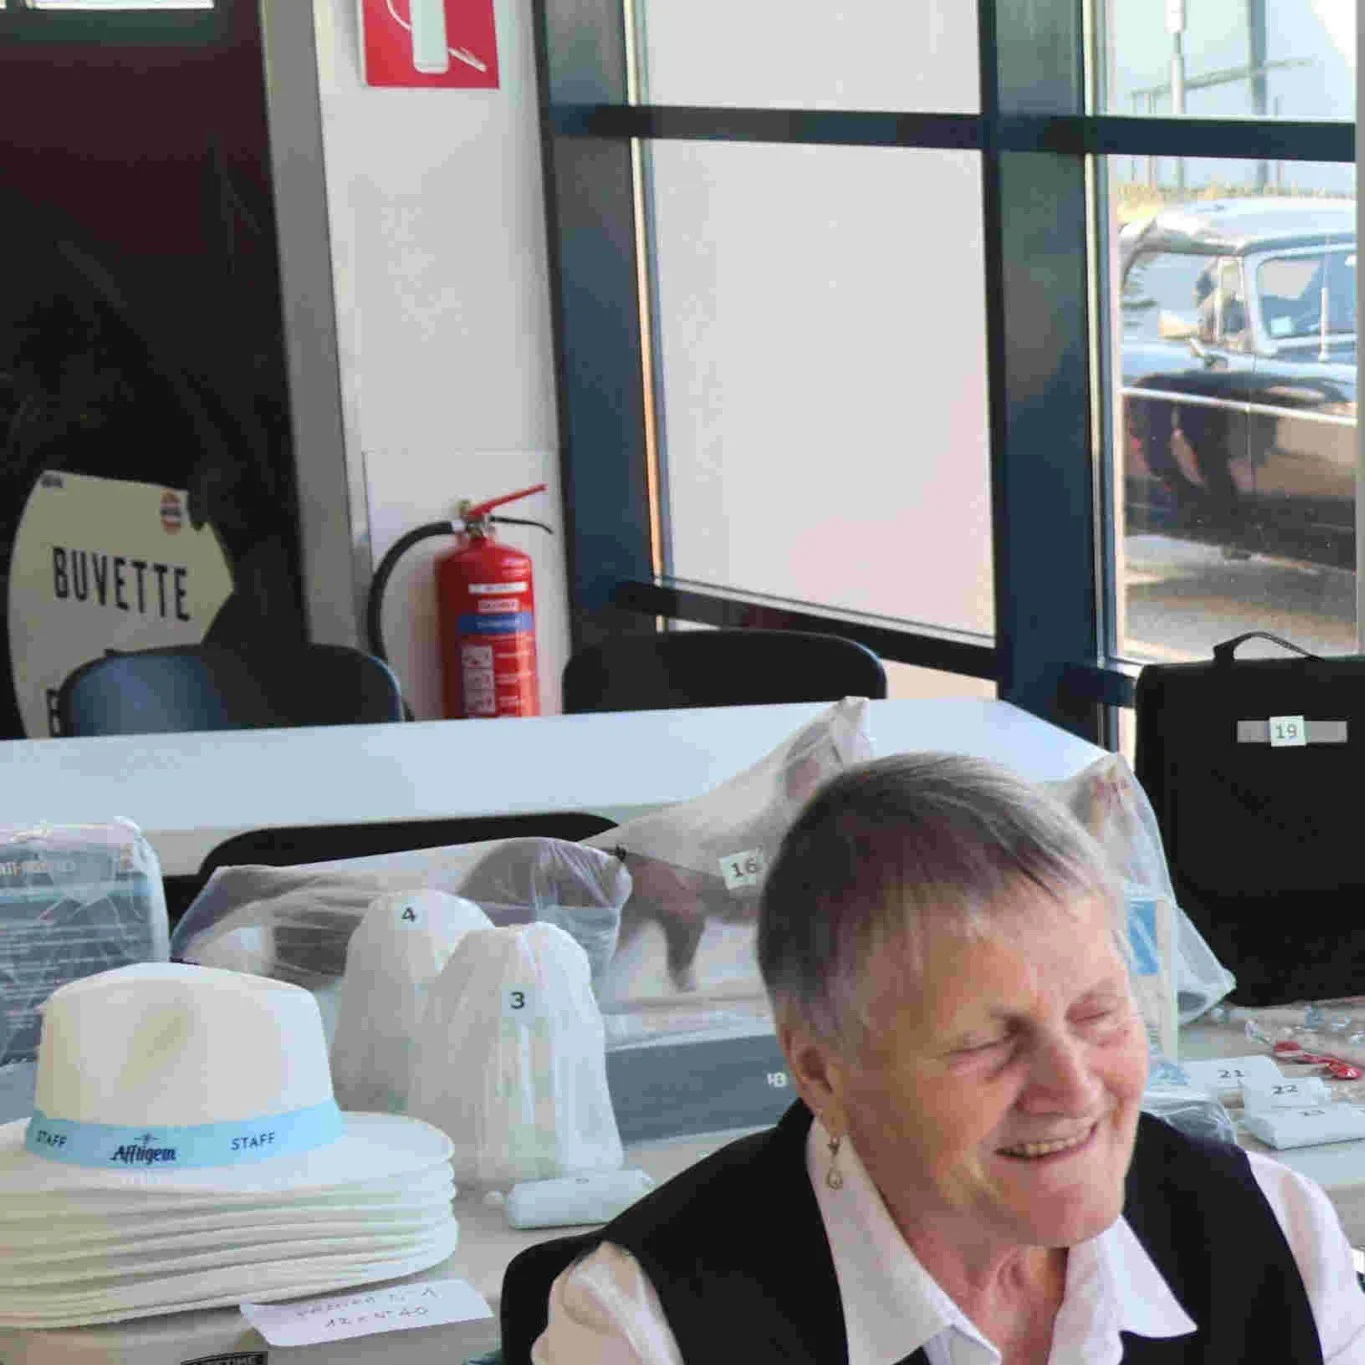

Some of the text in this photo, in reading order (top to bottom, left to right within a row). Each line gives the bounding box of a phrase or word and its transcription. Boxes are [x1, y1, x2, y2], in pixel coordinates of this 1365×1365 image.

[52, 546, 190, 622] BUVETTE
[1275, 723, 1297, 740] 19
[730, 858, 759, 878] 16
[401, 906, 416, 923] 4
[509, 991, 526, 1010] 3
[1272, 1084, 1299, 1095] 22
[36, 1129, 67, 1149] STAFF
[230, 1131, 276, 1151] STAFF
